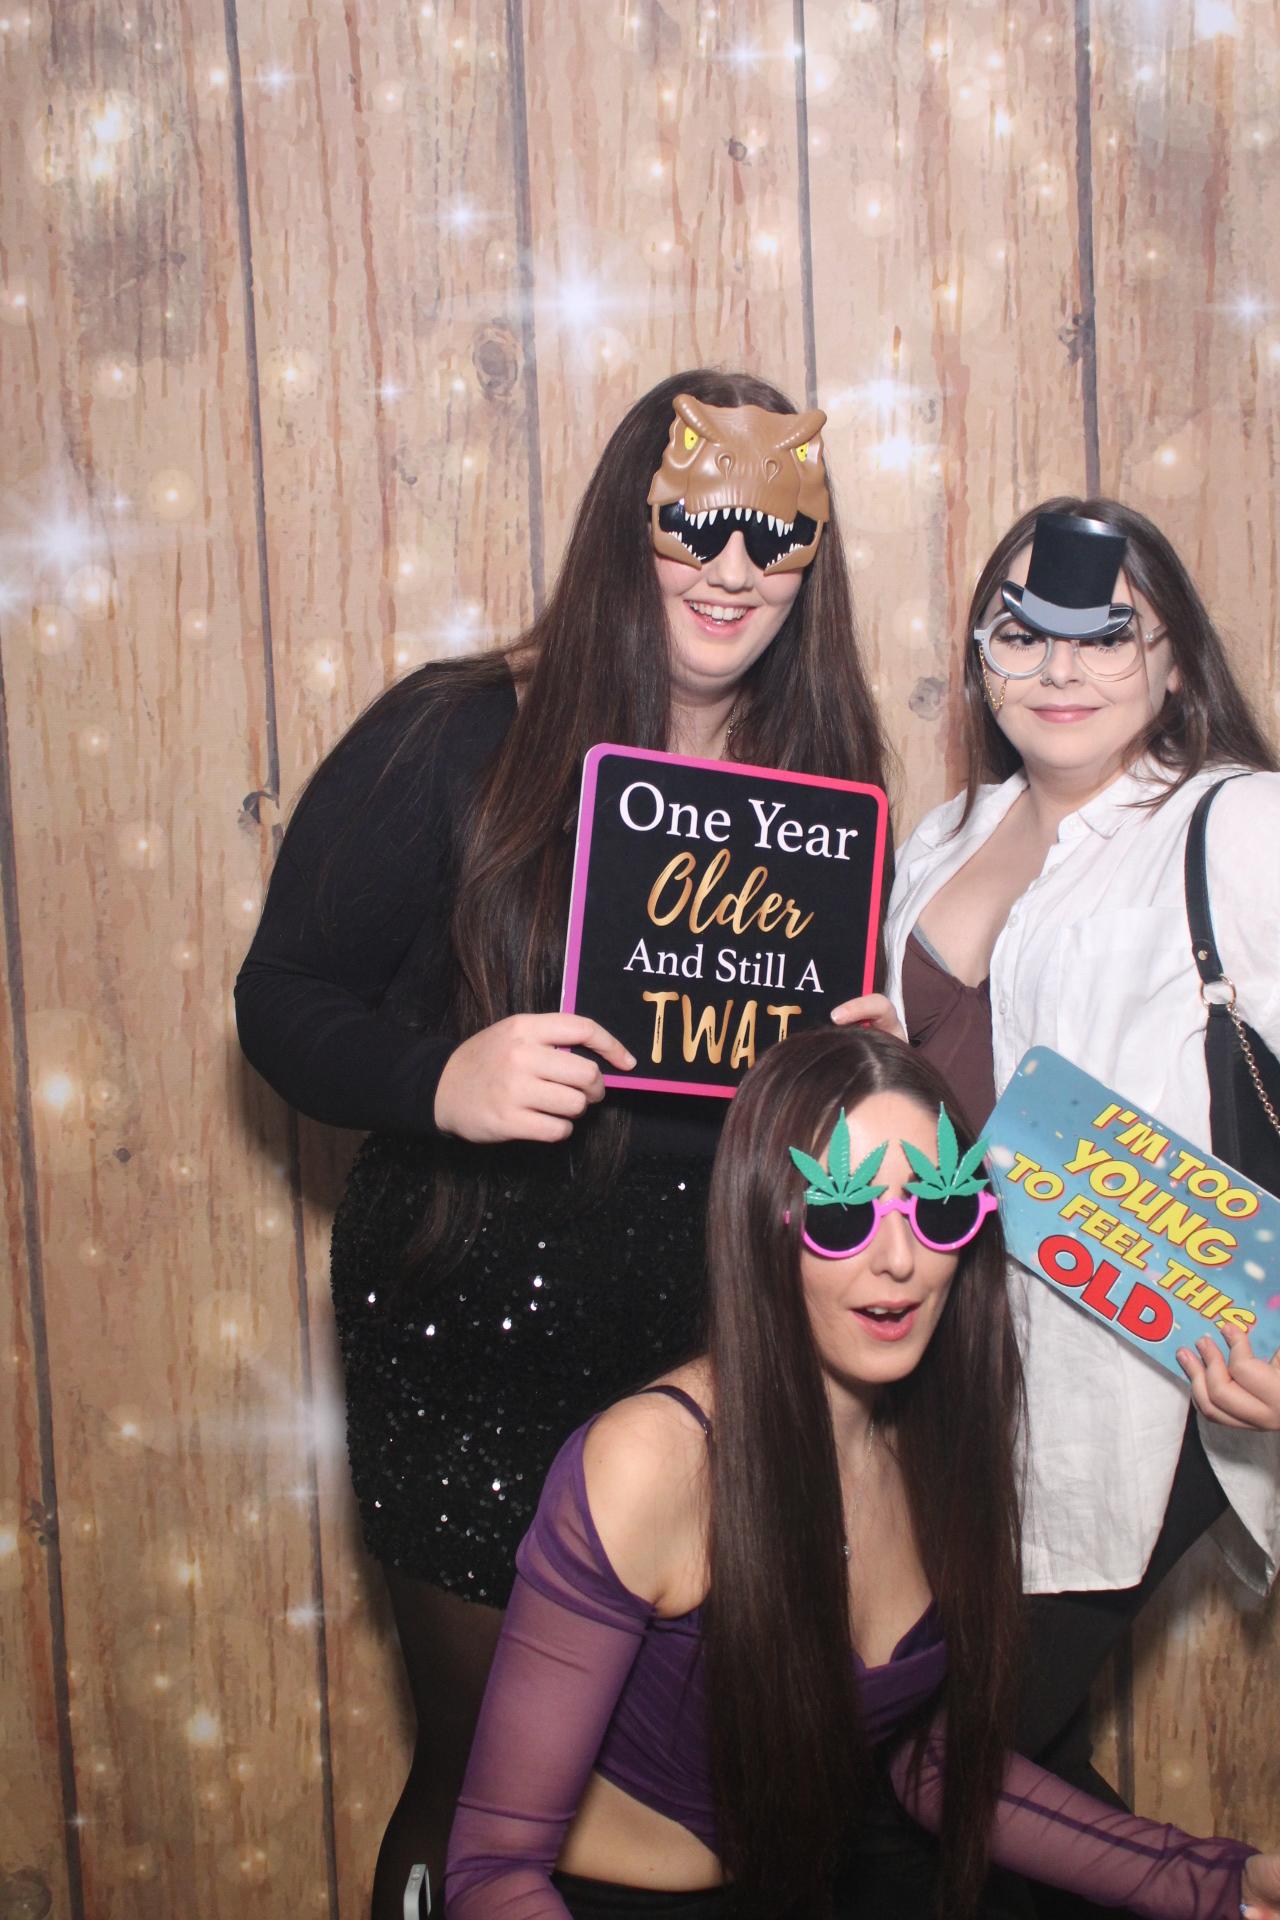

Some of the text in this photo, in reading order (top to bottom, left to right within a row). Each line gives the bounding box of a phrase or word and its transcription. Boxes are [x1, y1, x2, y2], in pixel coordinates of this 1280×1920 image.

[619, 781, 858, 860] One Year
[647, 849, 814, 939] Older
[623, 938, 824, 993] And Still A
[643, 991, 801, 1069] TWAT
[1063, 1138, 1237, 1266] YOUNG
[1092, 1103, 1259, 1218] I'M TOO
[1006, 1152, 1257, 1333] TO FEEL THIS
[1038, 1234, 1174, 1343] OLD
